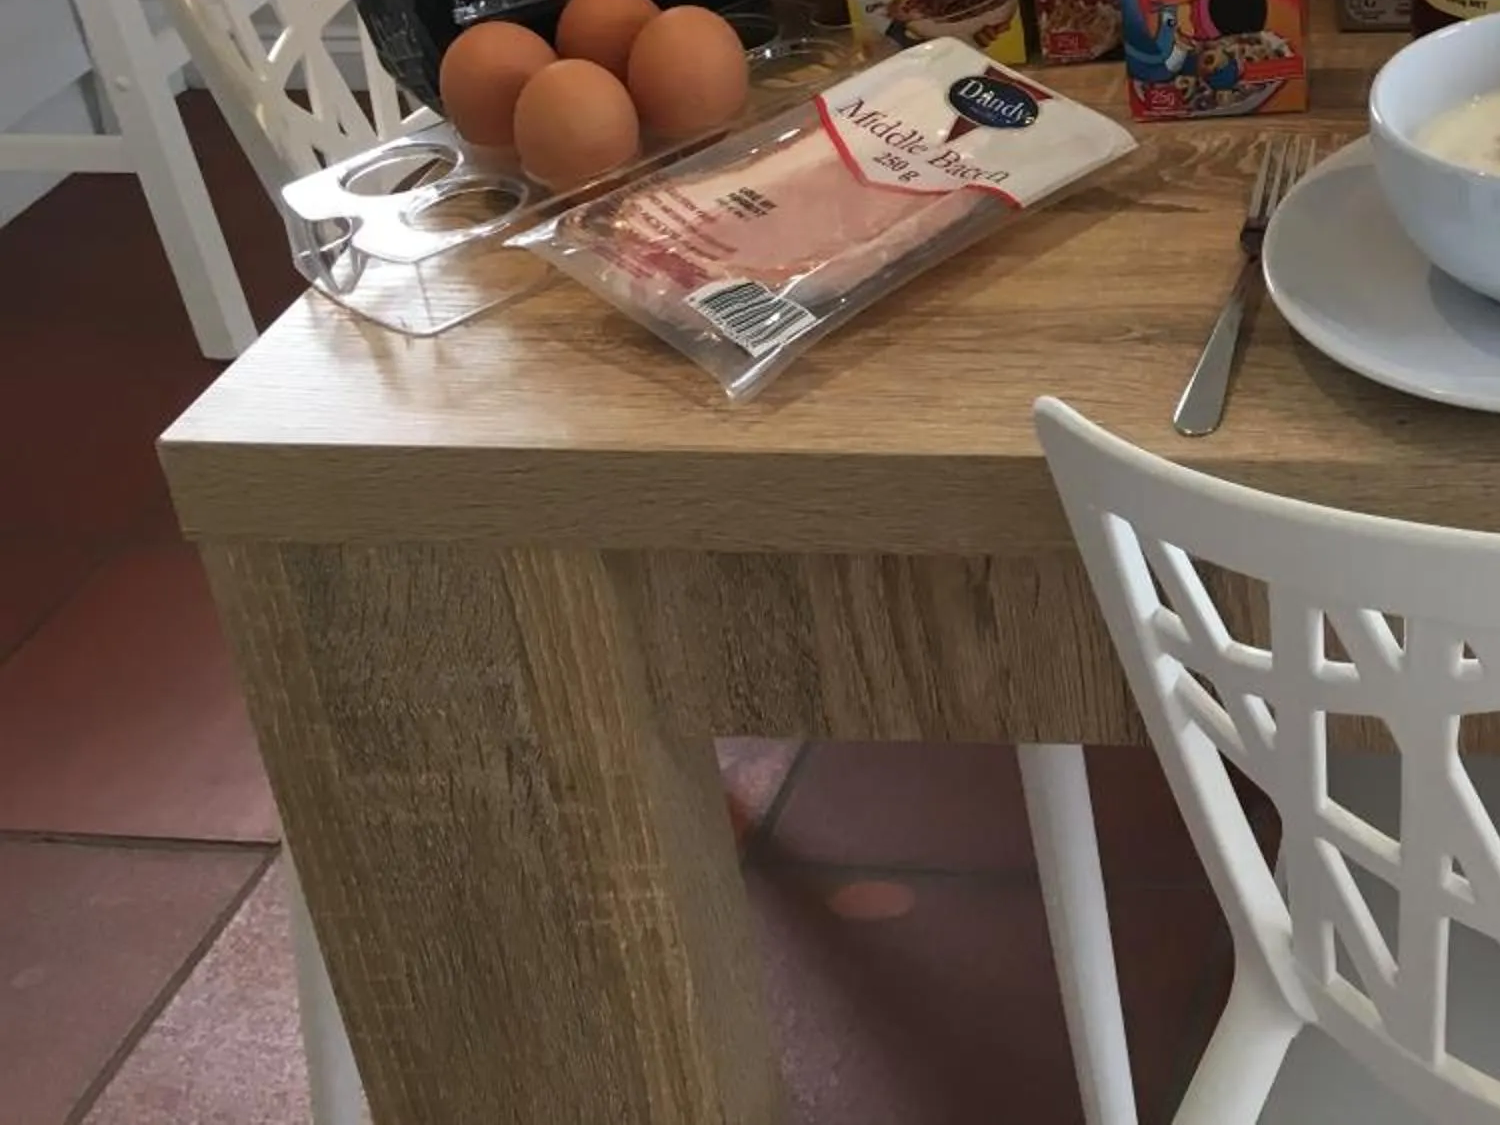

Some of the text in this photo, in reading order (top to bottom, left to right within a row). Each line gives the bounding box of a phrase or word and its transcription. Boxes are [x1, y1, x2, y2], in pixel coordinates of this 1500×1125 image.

[1151, 89, 1175, 107] 25g
[837, 97, 930, 156] Middle
[872, 151, 909, 173] 250
